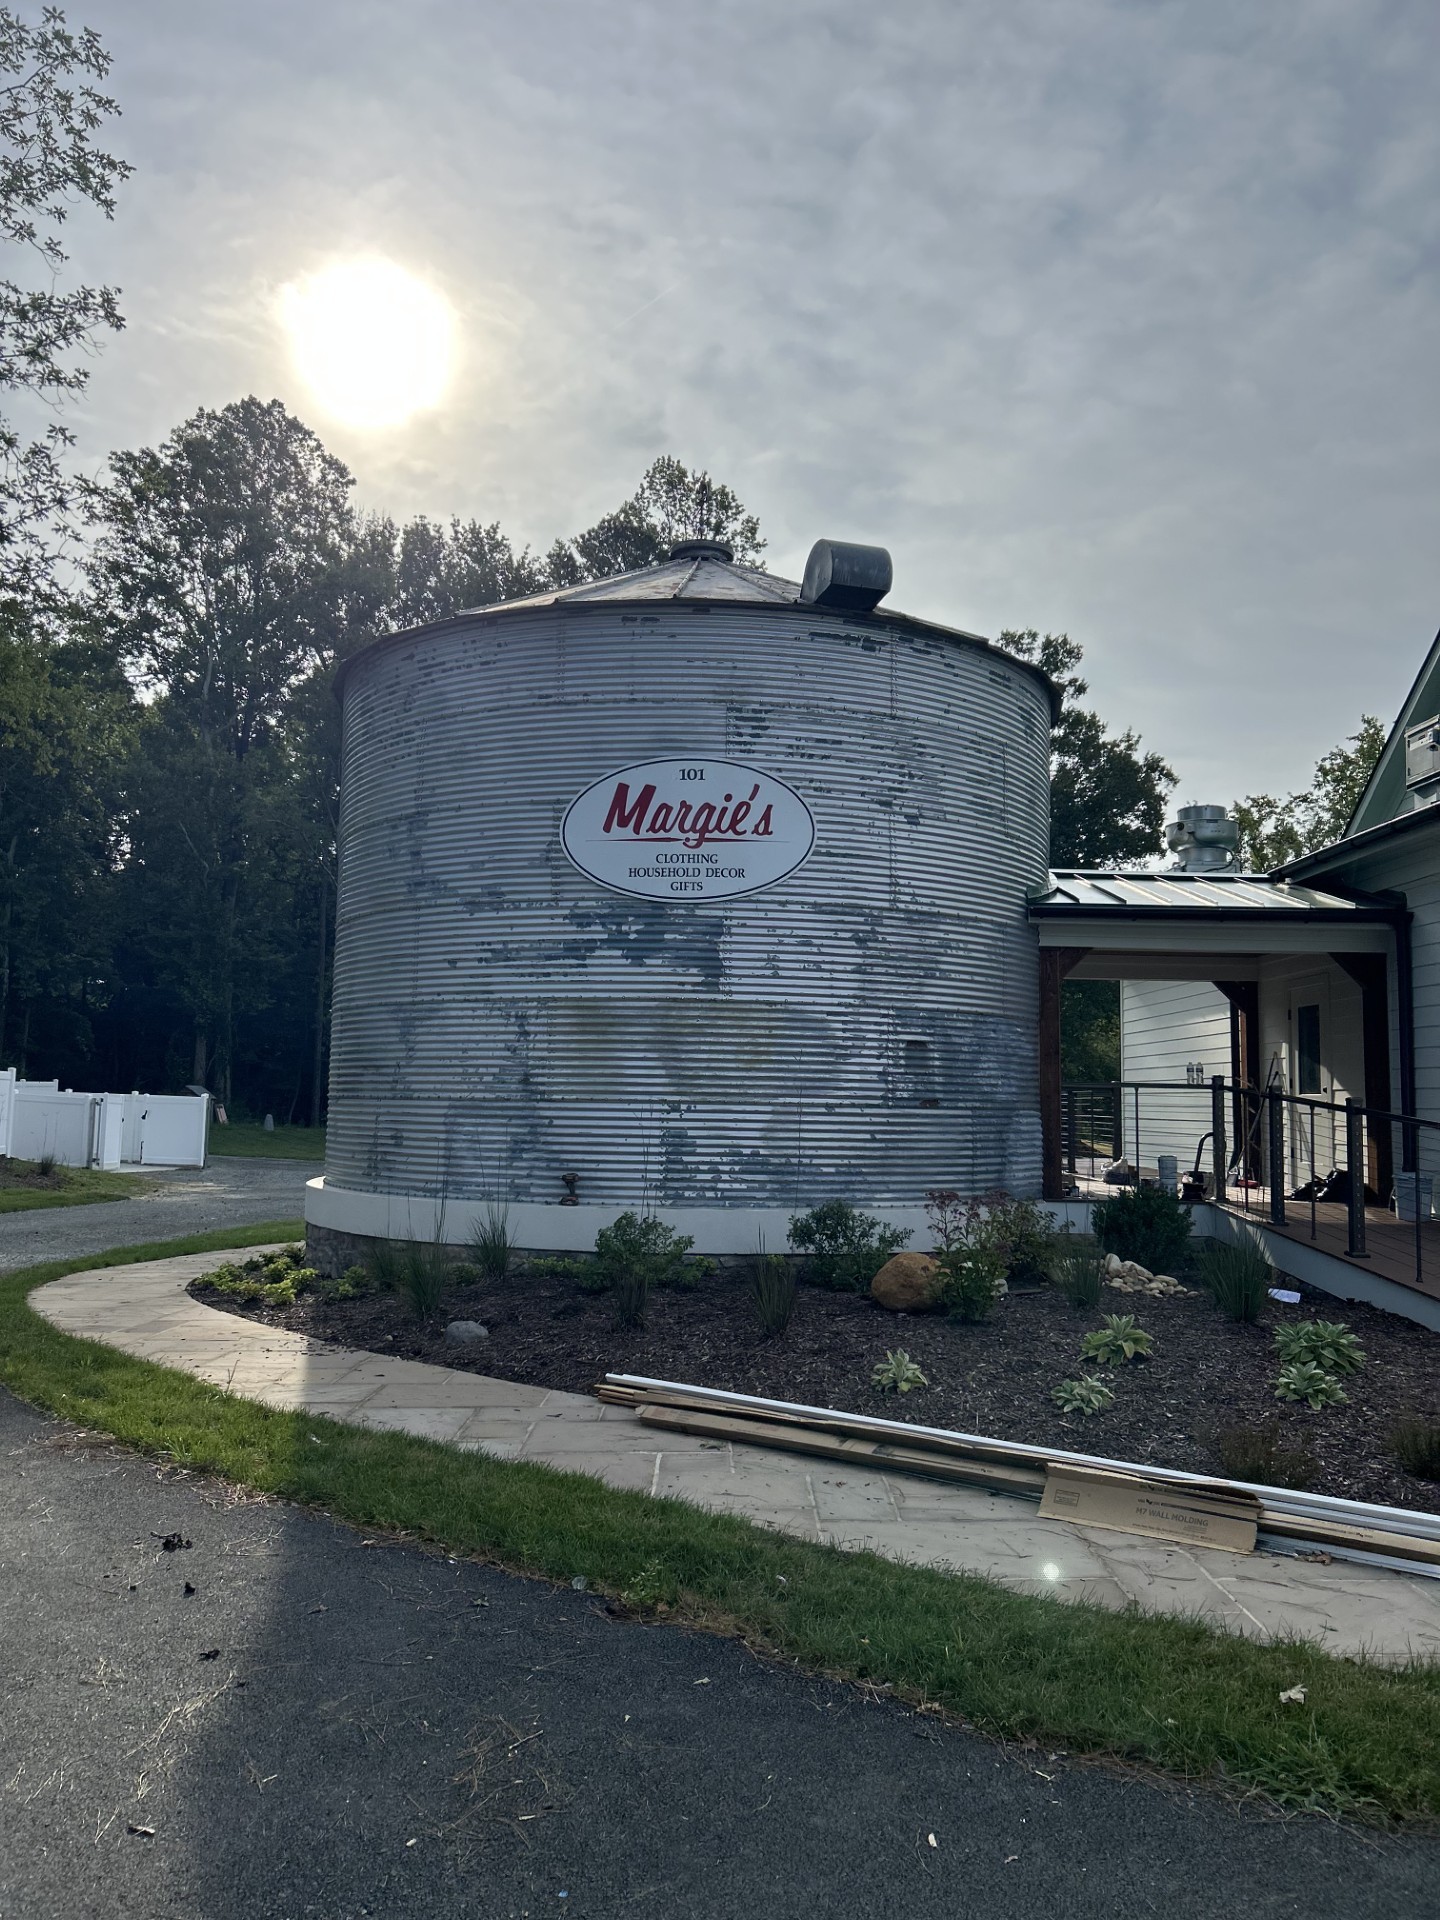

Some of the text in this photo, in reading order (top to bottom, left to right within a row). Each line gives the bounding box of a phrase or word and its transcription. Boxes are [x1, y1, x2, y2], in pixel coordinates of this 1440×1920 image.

[679, 769, 706, 781] 101
[602, 782, 774, 849] Margie's
[656, 853, 718, 865] CLOTHING
[628, 867, 745, 879] HOUSEHOLD DECOR
[670, 881, 703, 891] GIFTS
[1148, 1508, 1170, 1521] WALL
[1171, 1513, 1209, 1527] MOLDING
